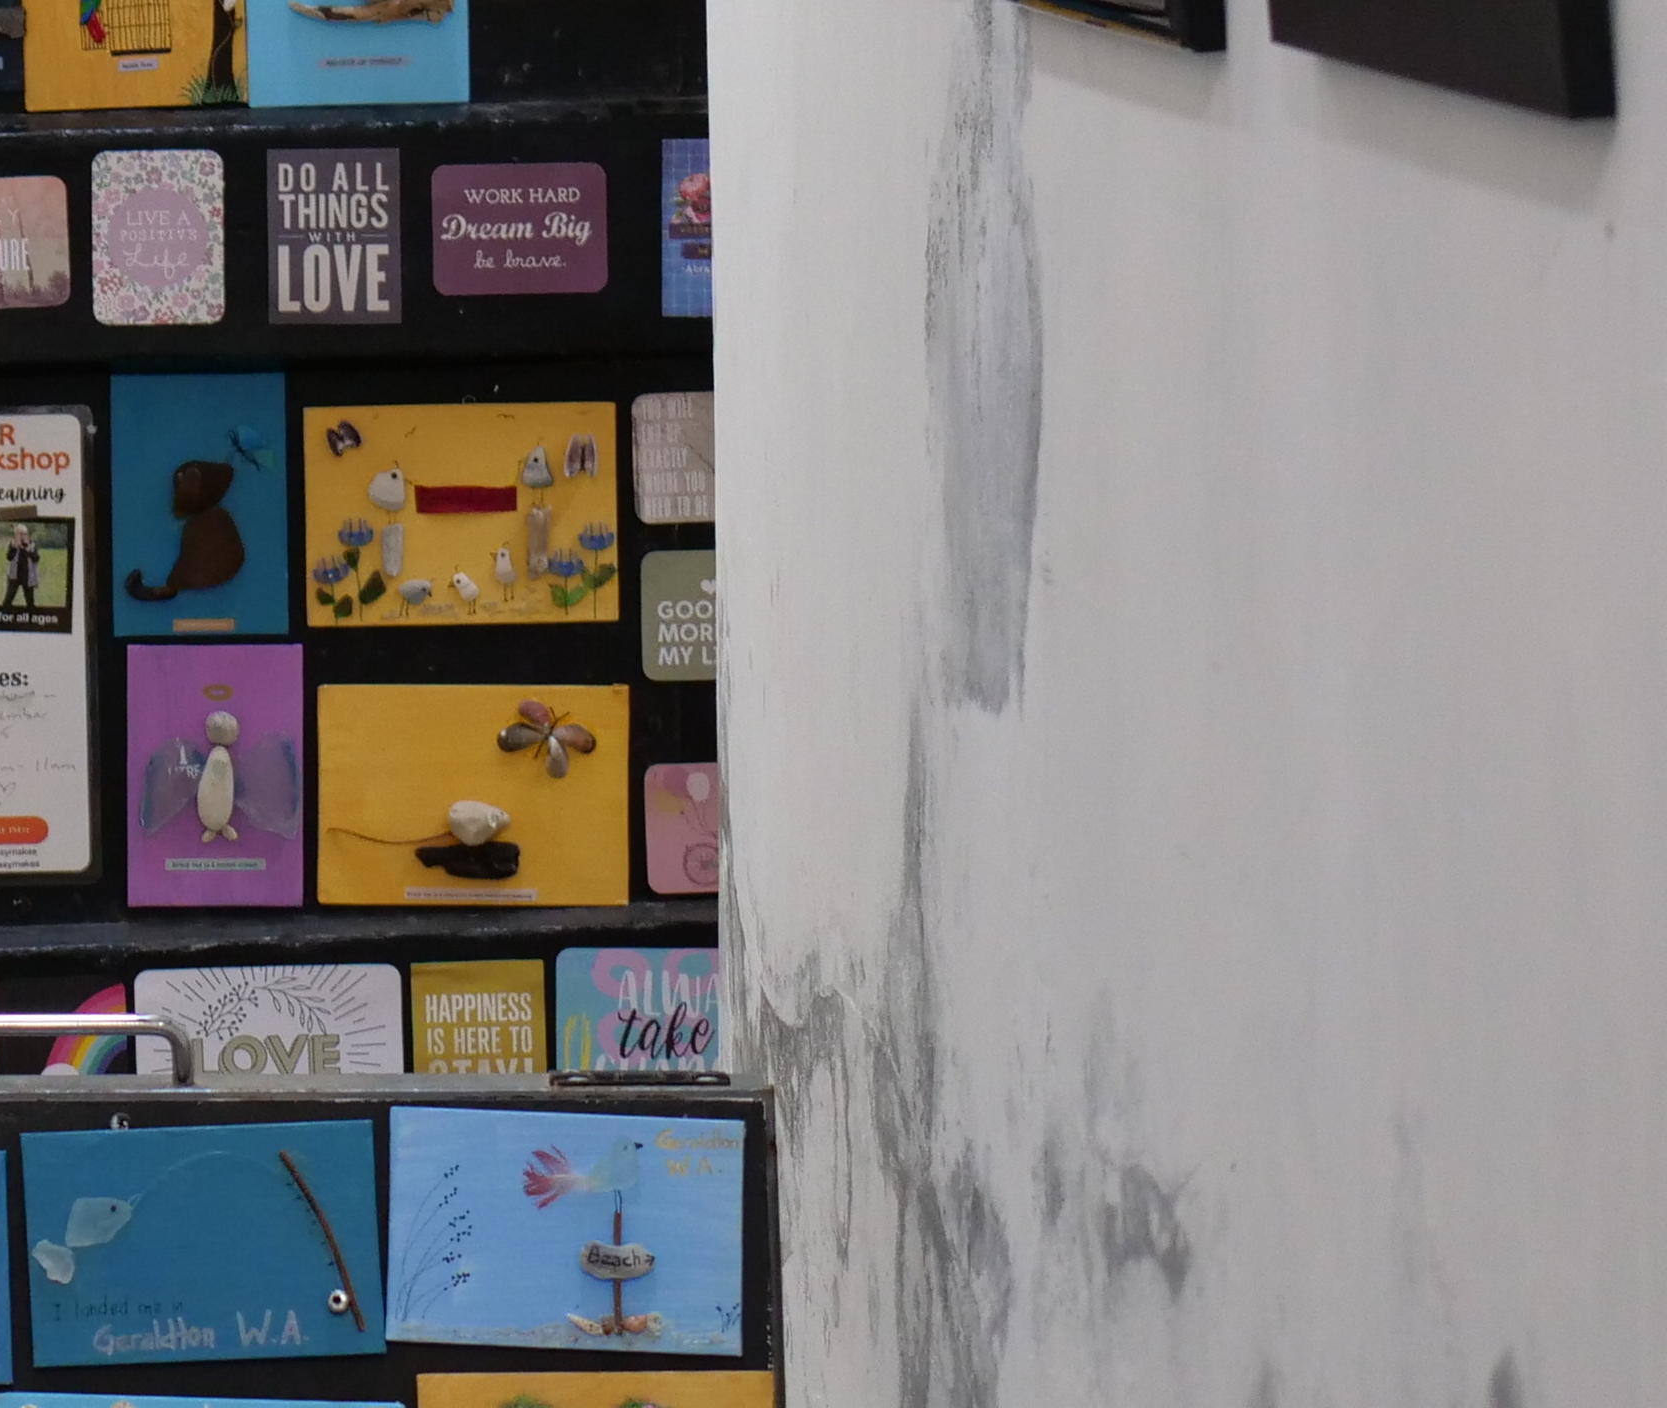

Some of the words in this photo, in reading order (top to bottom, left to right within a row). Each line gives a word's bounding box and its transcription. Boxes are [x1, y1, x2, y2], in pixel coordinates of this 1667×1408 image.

[278, 162, 316, 192] DO
[332, 162, 389, 192] ALL
[464, 189, 524, 204] WORK
[529, 187, 580, 203] HARD
[127, 210, 170, 226] LIVE
[178, 209, 191, 226] A
[278, 193, 388, 229] THINGS
[121, 228, 197, 242] POSITIVE
[308, 231, 356, 242] WITH
[441, 214, 533, 240] Dream
[542, 212, 592, 246] Big
[123, 243, 190, 280] Life
[474, 249, 495, 269] be
[503, 249, 566, 268] brave.
[278, 244, 389, 313] LOVE
[16, 612, 29, 623] all
[30, 614, 58, 626] ages
[658, 646, 693, 666] MY
[425, 993, 531, 1023] HAPPINESS
[427, 1028, 445, 1054] IS
[453, 1026, 501, 1053] HERE
[511, 1025, 533, 1052] TO
[618, 1002, 715, 1060] take
[191, 1033, 341, 1074] LOVE
[93, 1317, 215, 1355] Geraldton
